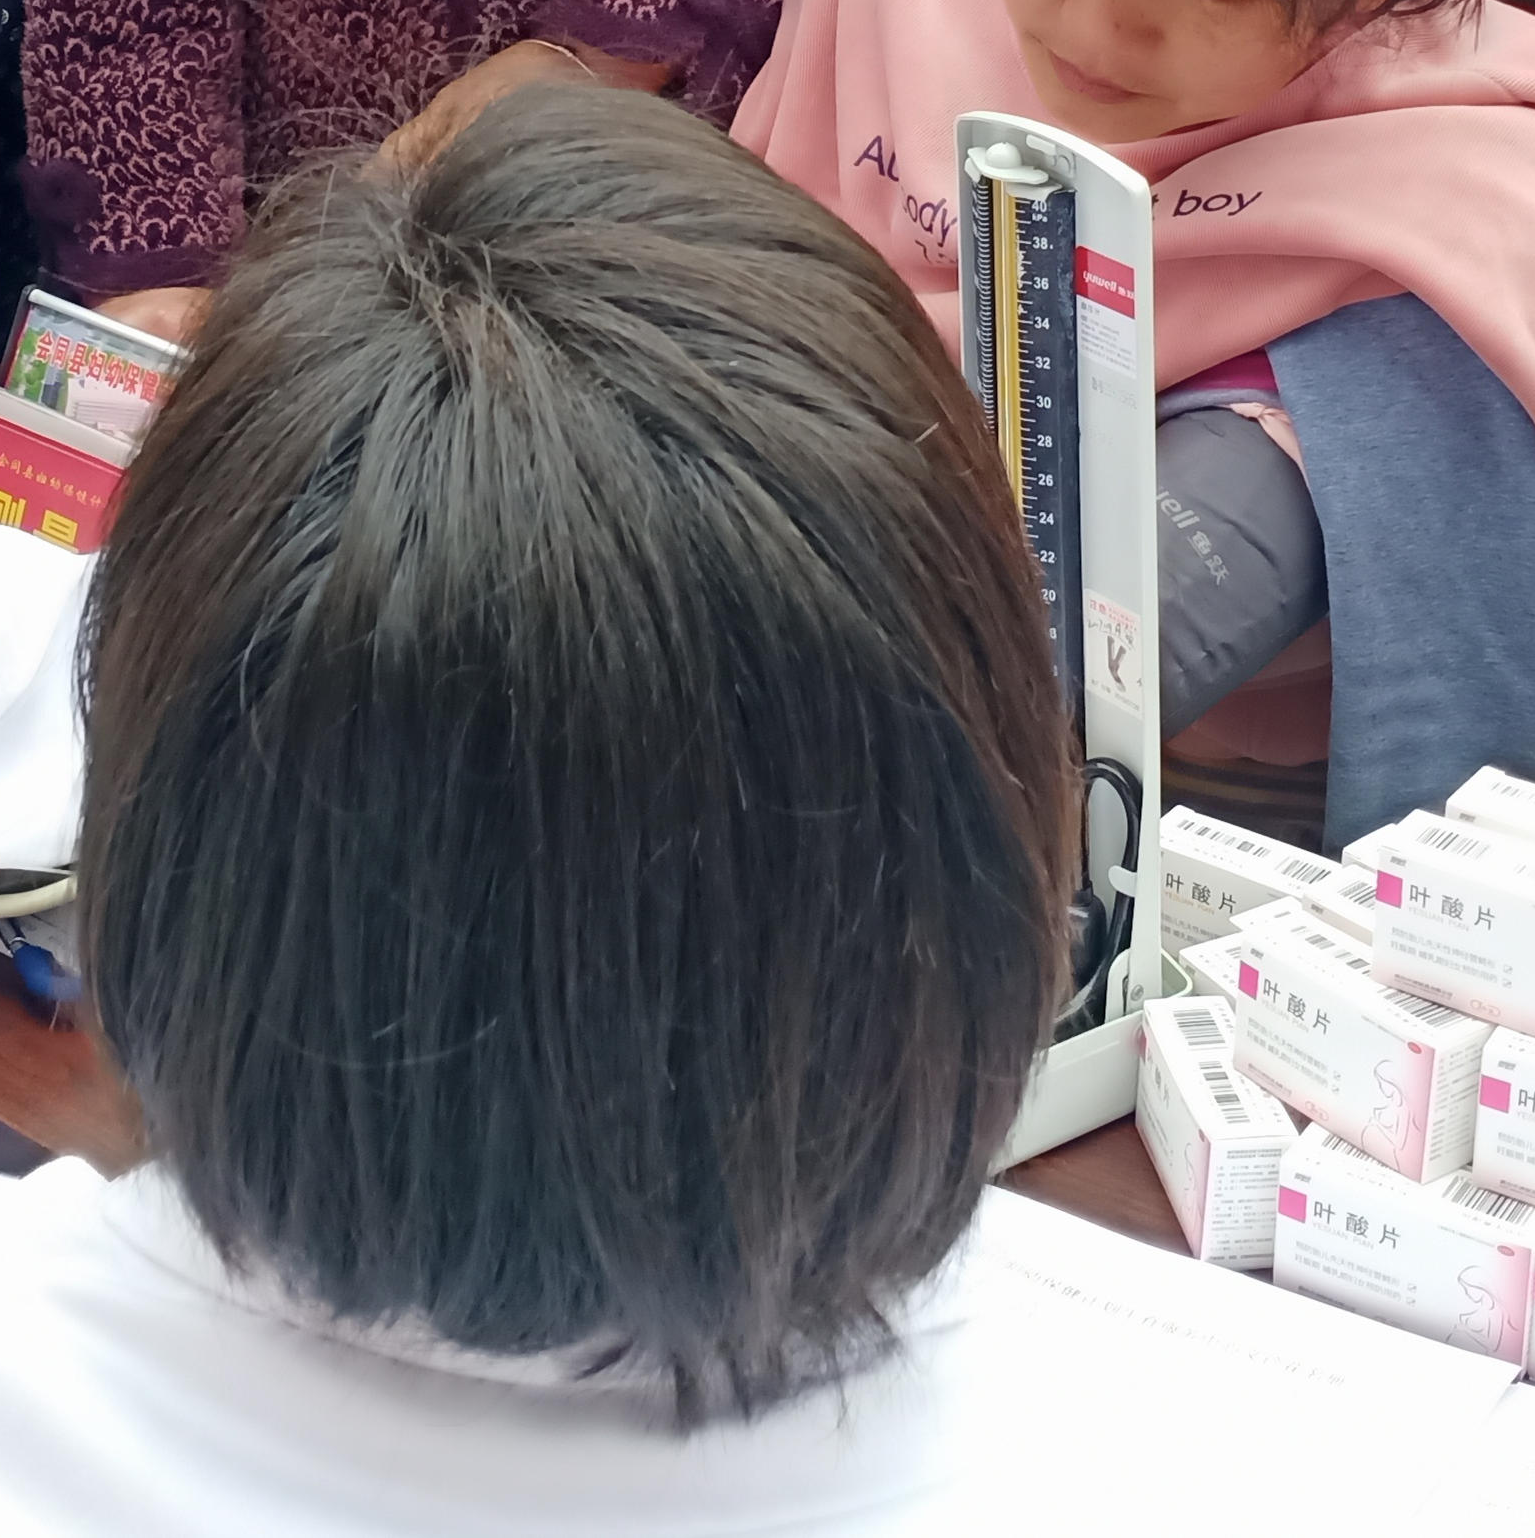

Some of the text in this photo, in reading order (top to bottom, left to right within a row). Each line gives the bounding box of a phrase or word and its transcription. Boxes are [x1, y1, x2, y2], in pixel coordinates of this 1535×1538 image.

[1173, 189, 1263, 217] boy
[1032, 236, 1048, 250] 38
[1033, 276, 1049, 290] 36
[1083, 270, 1117, 293] yuwell
[1034, 317, 1050, 331] 34
[1035, 356, 1051, 370] 32
[1036, 395, 1052, 409] 30
[1036, 434, 1053, 448] 28
[1037, 473, 1054, 487] 26
[1038, 512, 1055, 526] 24
[1039, 550, 1056, 564] 22
[1042, 589, 1057, 602] 20
[1165, 872, 1237, 914] 叶酸片
[1409, 884, 1496, 931] 叶酸片
[1263, 978, 1331, 1035] 叶酸片
[1313, 1200, 1401, 1249] 叶酸片
